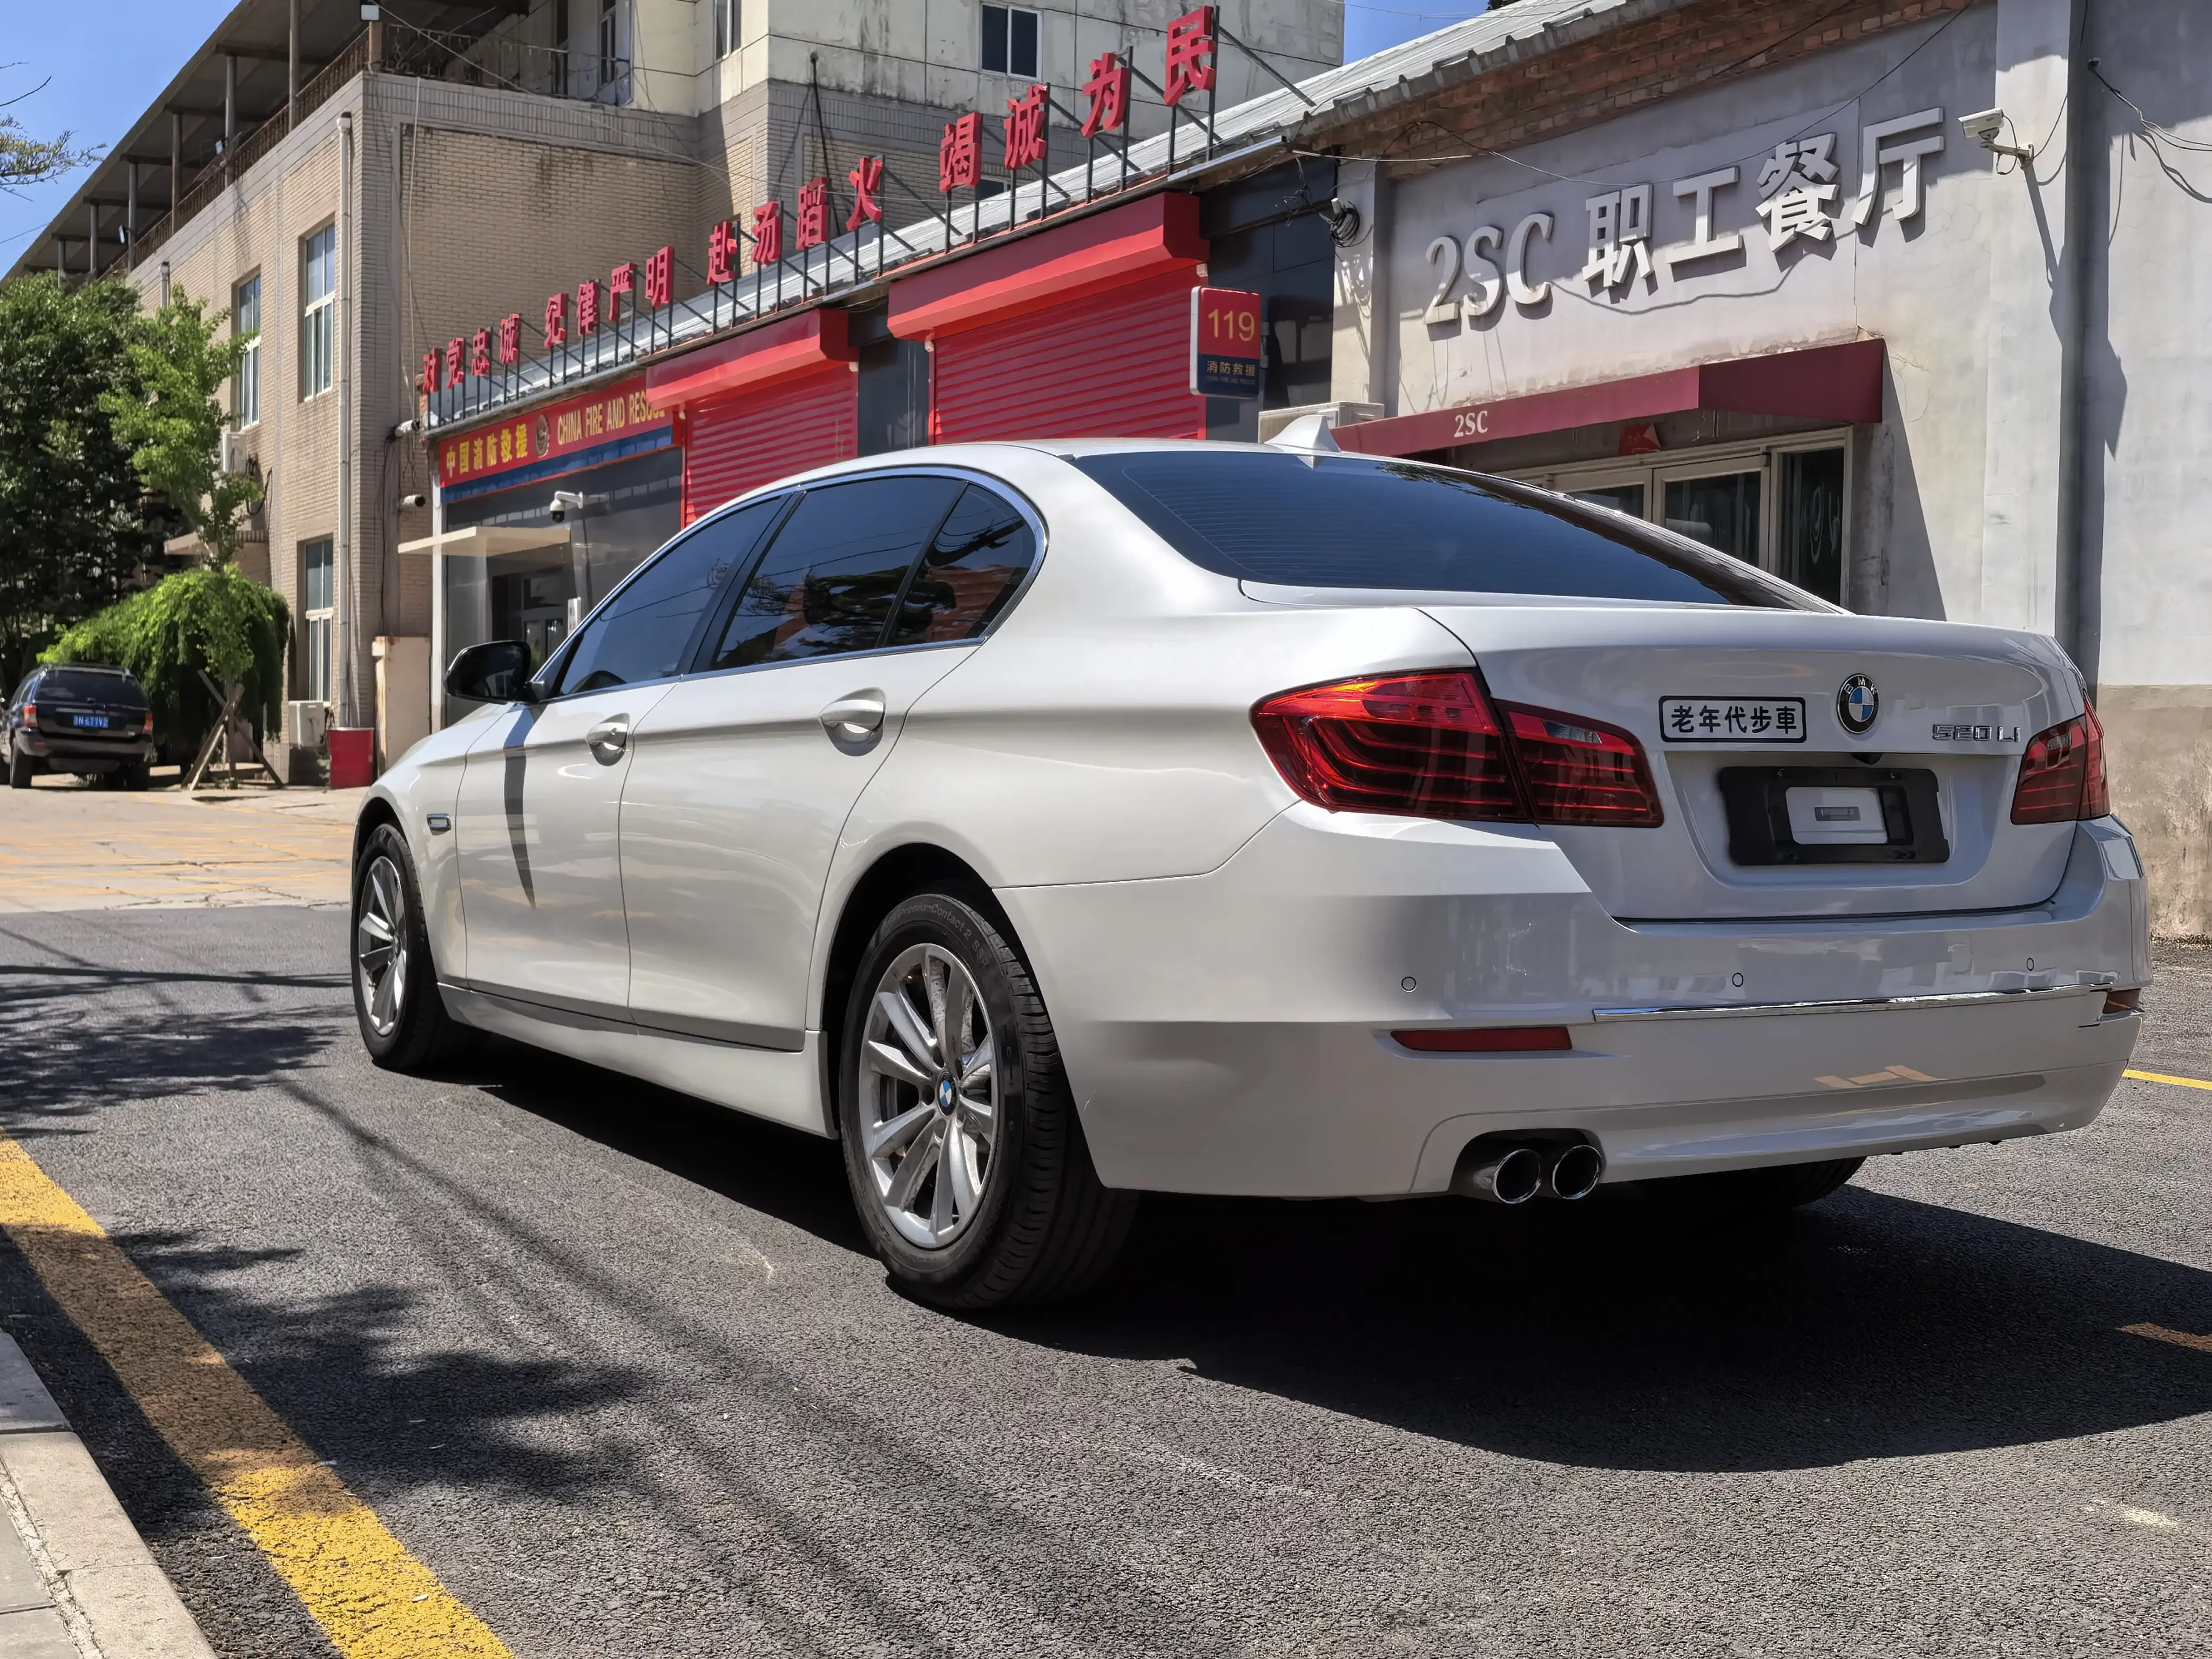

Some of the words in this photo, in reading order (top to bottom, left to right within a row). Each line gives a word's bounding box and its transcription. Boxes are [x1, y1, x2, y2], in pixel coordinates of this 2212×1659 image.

[544, 246, 674, 349] 纪律严明
[706, 156, 883, 286] 赴汤蹈火
[939, 5, 1217, 192] 竭诚为民
[1425, 213, 1554, 326] 2SC
[1582, 107, 1944, 288] 职工餐厅
[1208, 308, 1255, 341] 119
[1206, 360, 1256, 377] 消防救援
[557, 409, 582, 445] CHINA
[585, 403, 603, 438] FIRE
[606, 397, 625, 431] AND
[629, 389, 665, 425] RES
[1454, 410, 1488, 437] 2SC
[1843, 677, 1878, 695] BMW
[1671, 705, 1797, 734] 老年代步車
